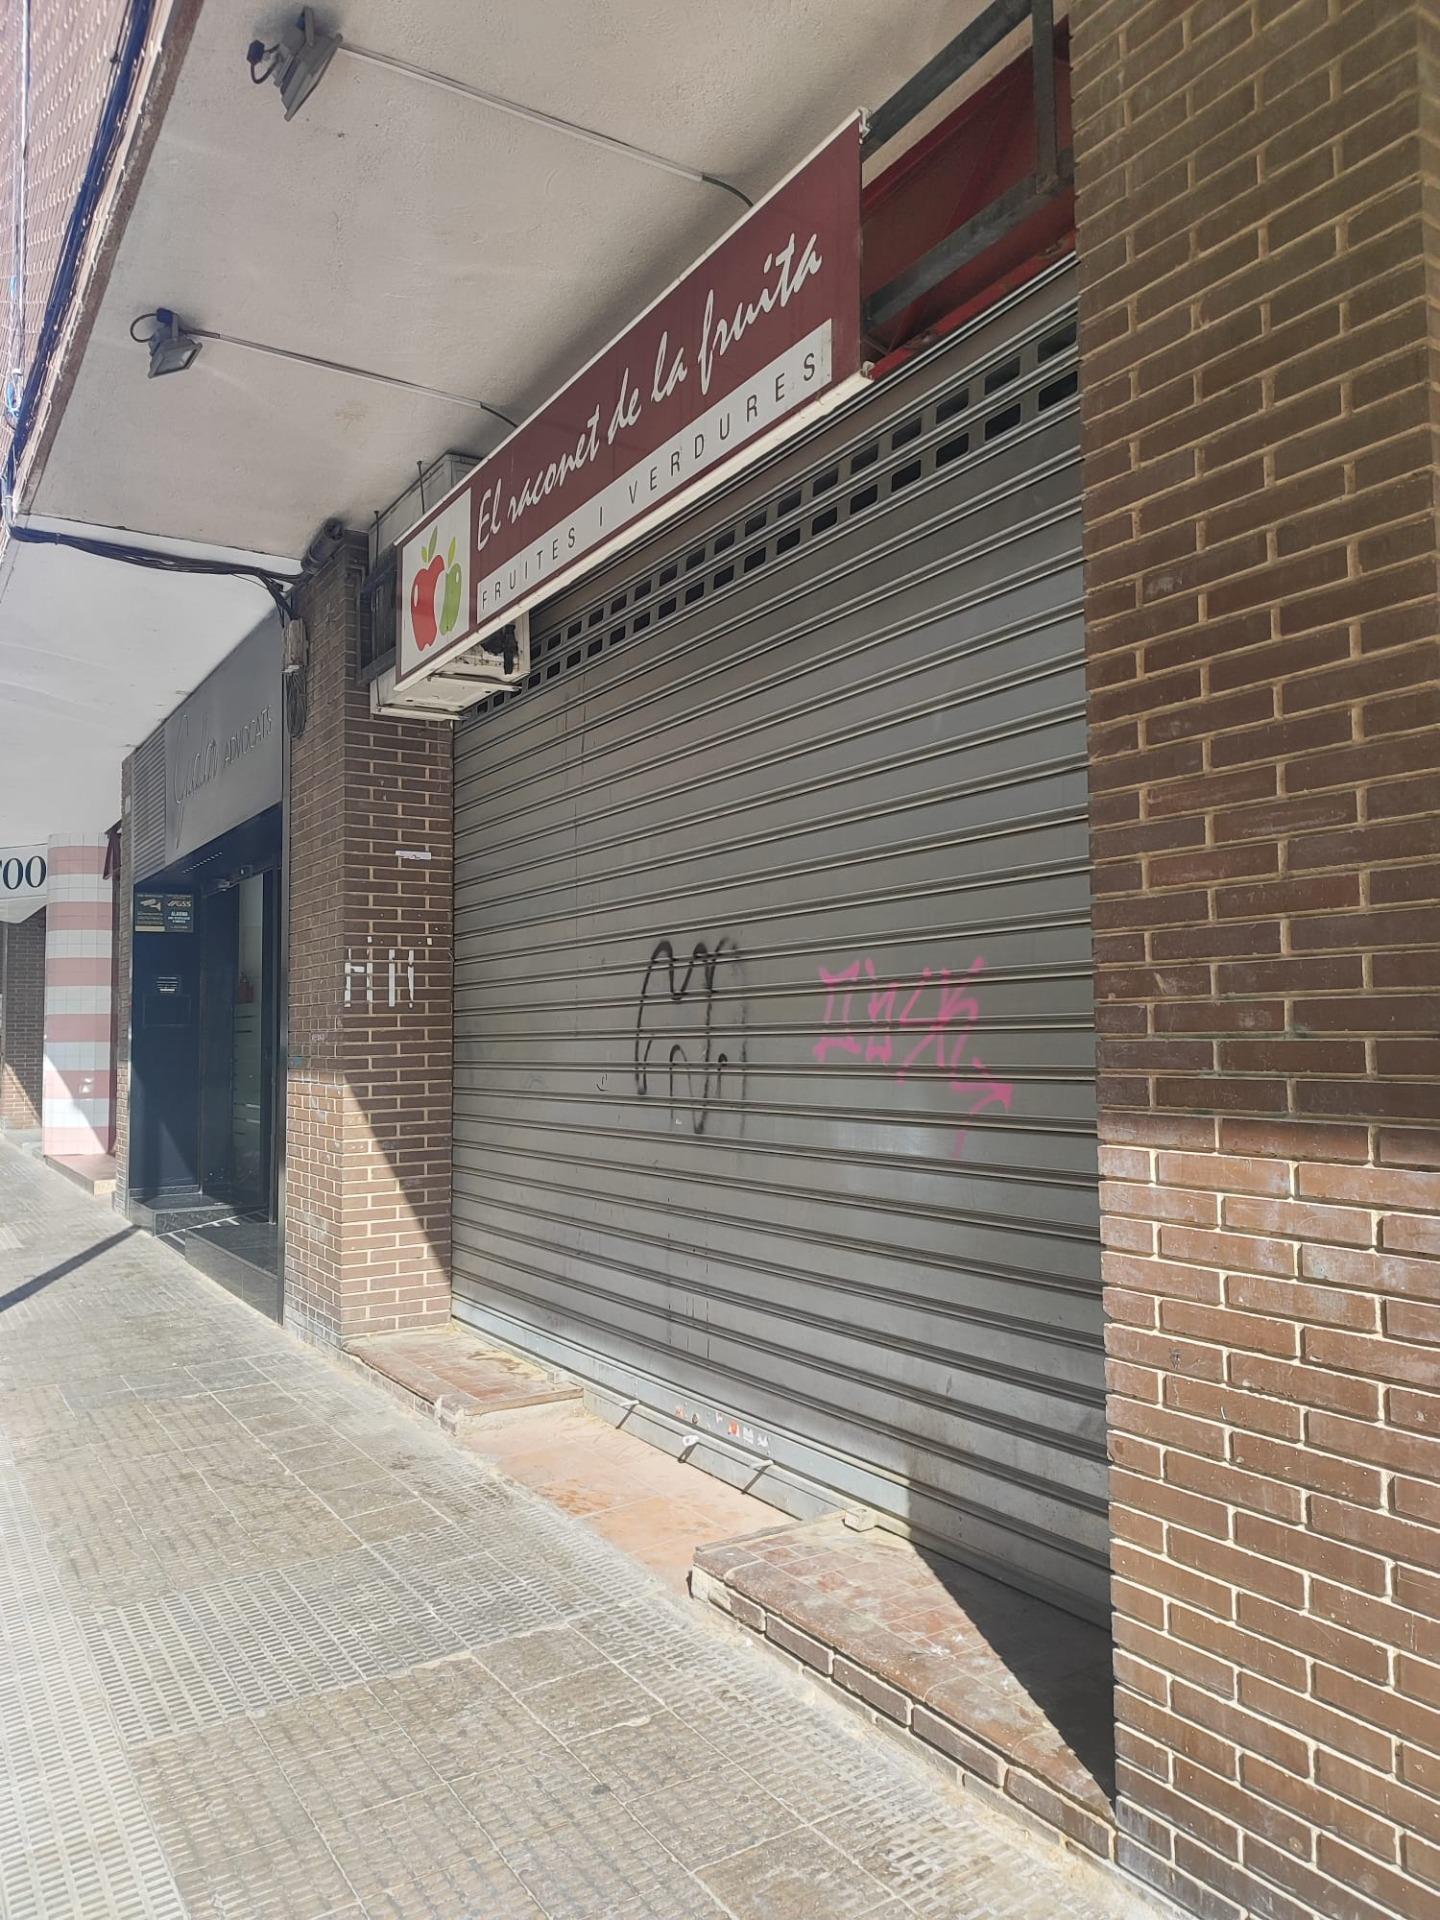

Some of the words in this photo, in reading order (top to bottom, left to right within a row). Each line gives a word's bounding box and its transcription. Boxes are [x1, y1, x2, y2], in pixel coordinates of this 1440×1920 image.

[476, 477, 502, 552] El
[507, 403, 600, 524] raconet
[607, 367, 642, 445] de
[650, 330, 688, 403] la
[697, 231, 823, 396] fruita
[481, 526, 577, 611] FRUITES
[599, 505, 604, 527] I
[628, 352, 816, 505] VERDURES
[0, 854, 47, 890] OO
